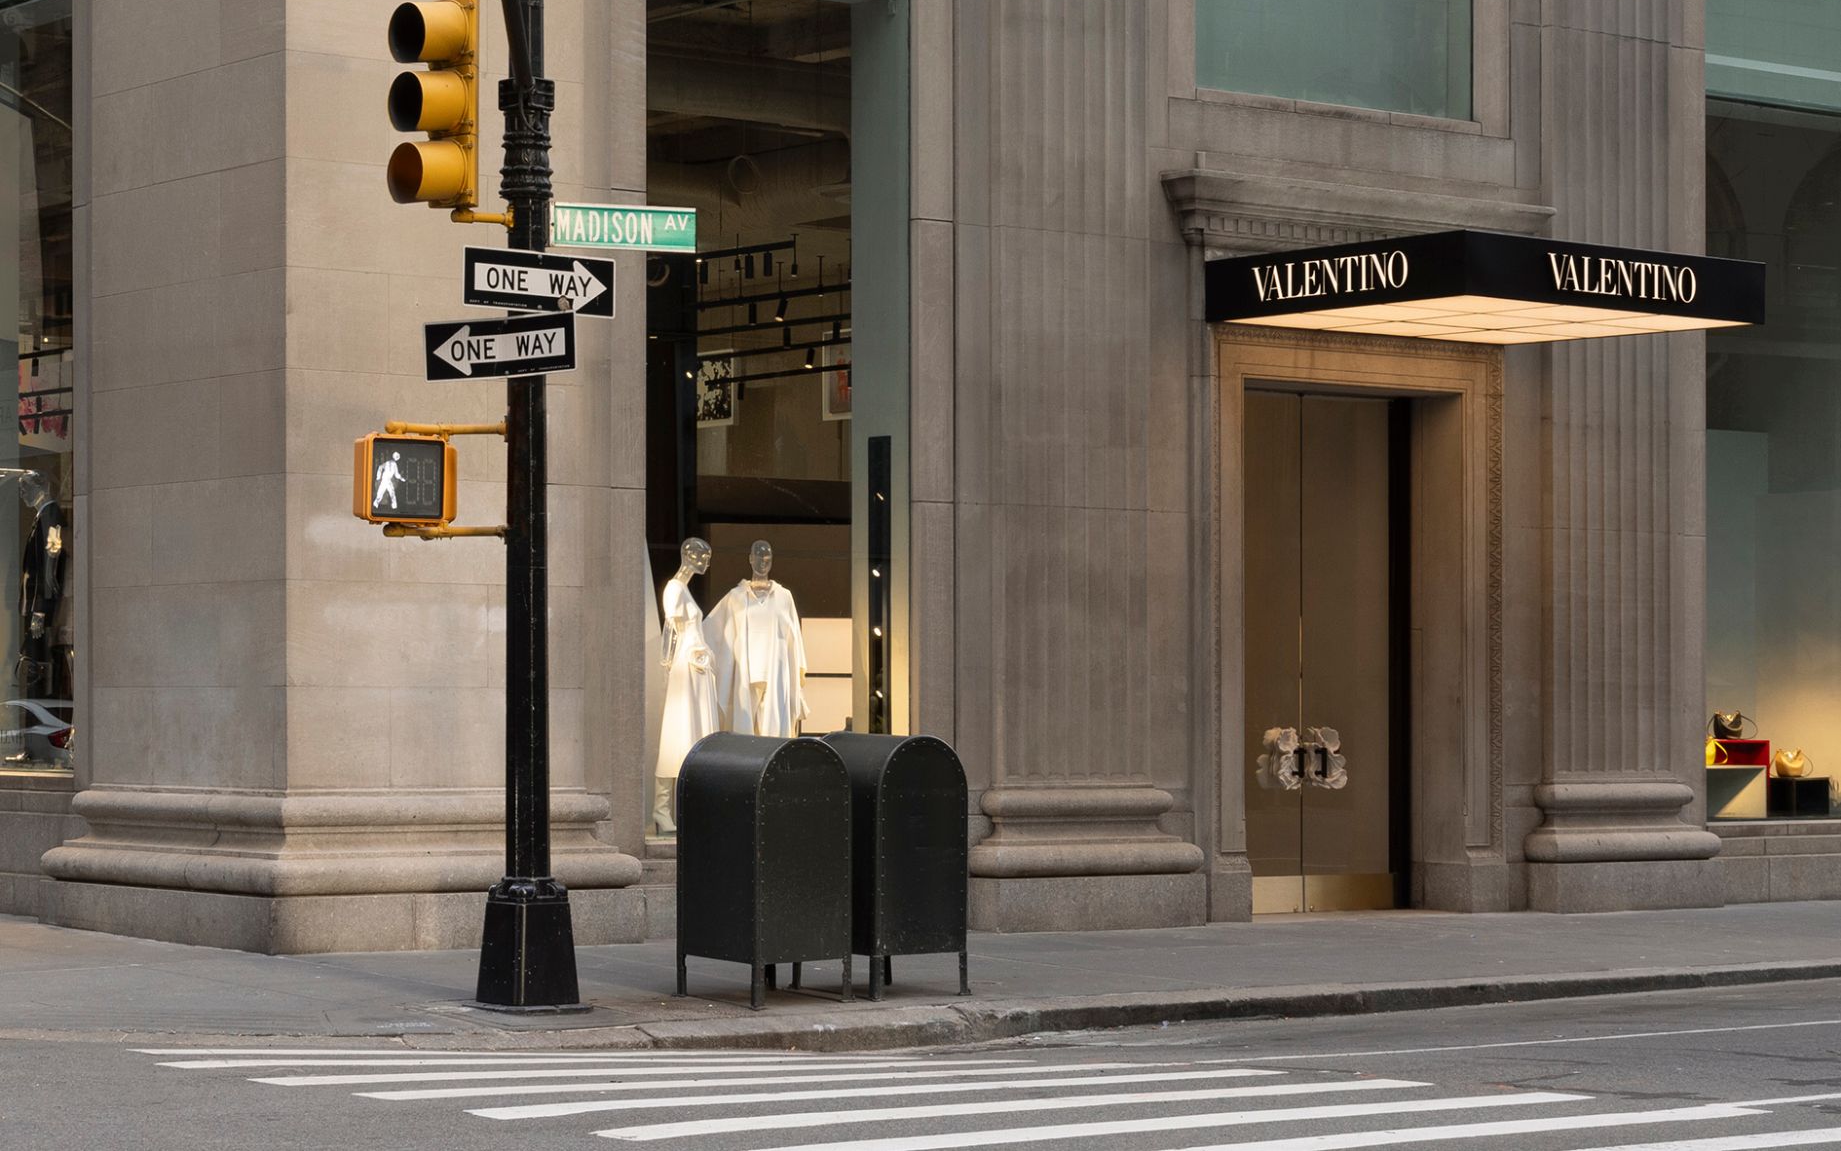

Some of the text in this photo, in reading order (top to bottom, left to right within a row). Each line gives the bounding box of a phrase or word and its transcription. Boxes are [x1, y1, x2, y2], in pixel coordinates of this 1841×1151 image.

[556, 209, 689, 244] MADISON AV
[486, 266, 592, 298] ONE WAY
[1251, 250, 1409, 302] VALENTINO
[1547, 252, 1697, 304] VALENTINO
[450, 331, 557, 362] ONE WAY
